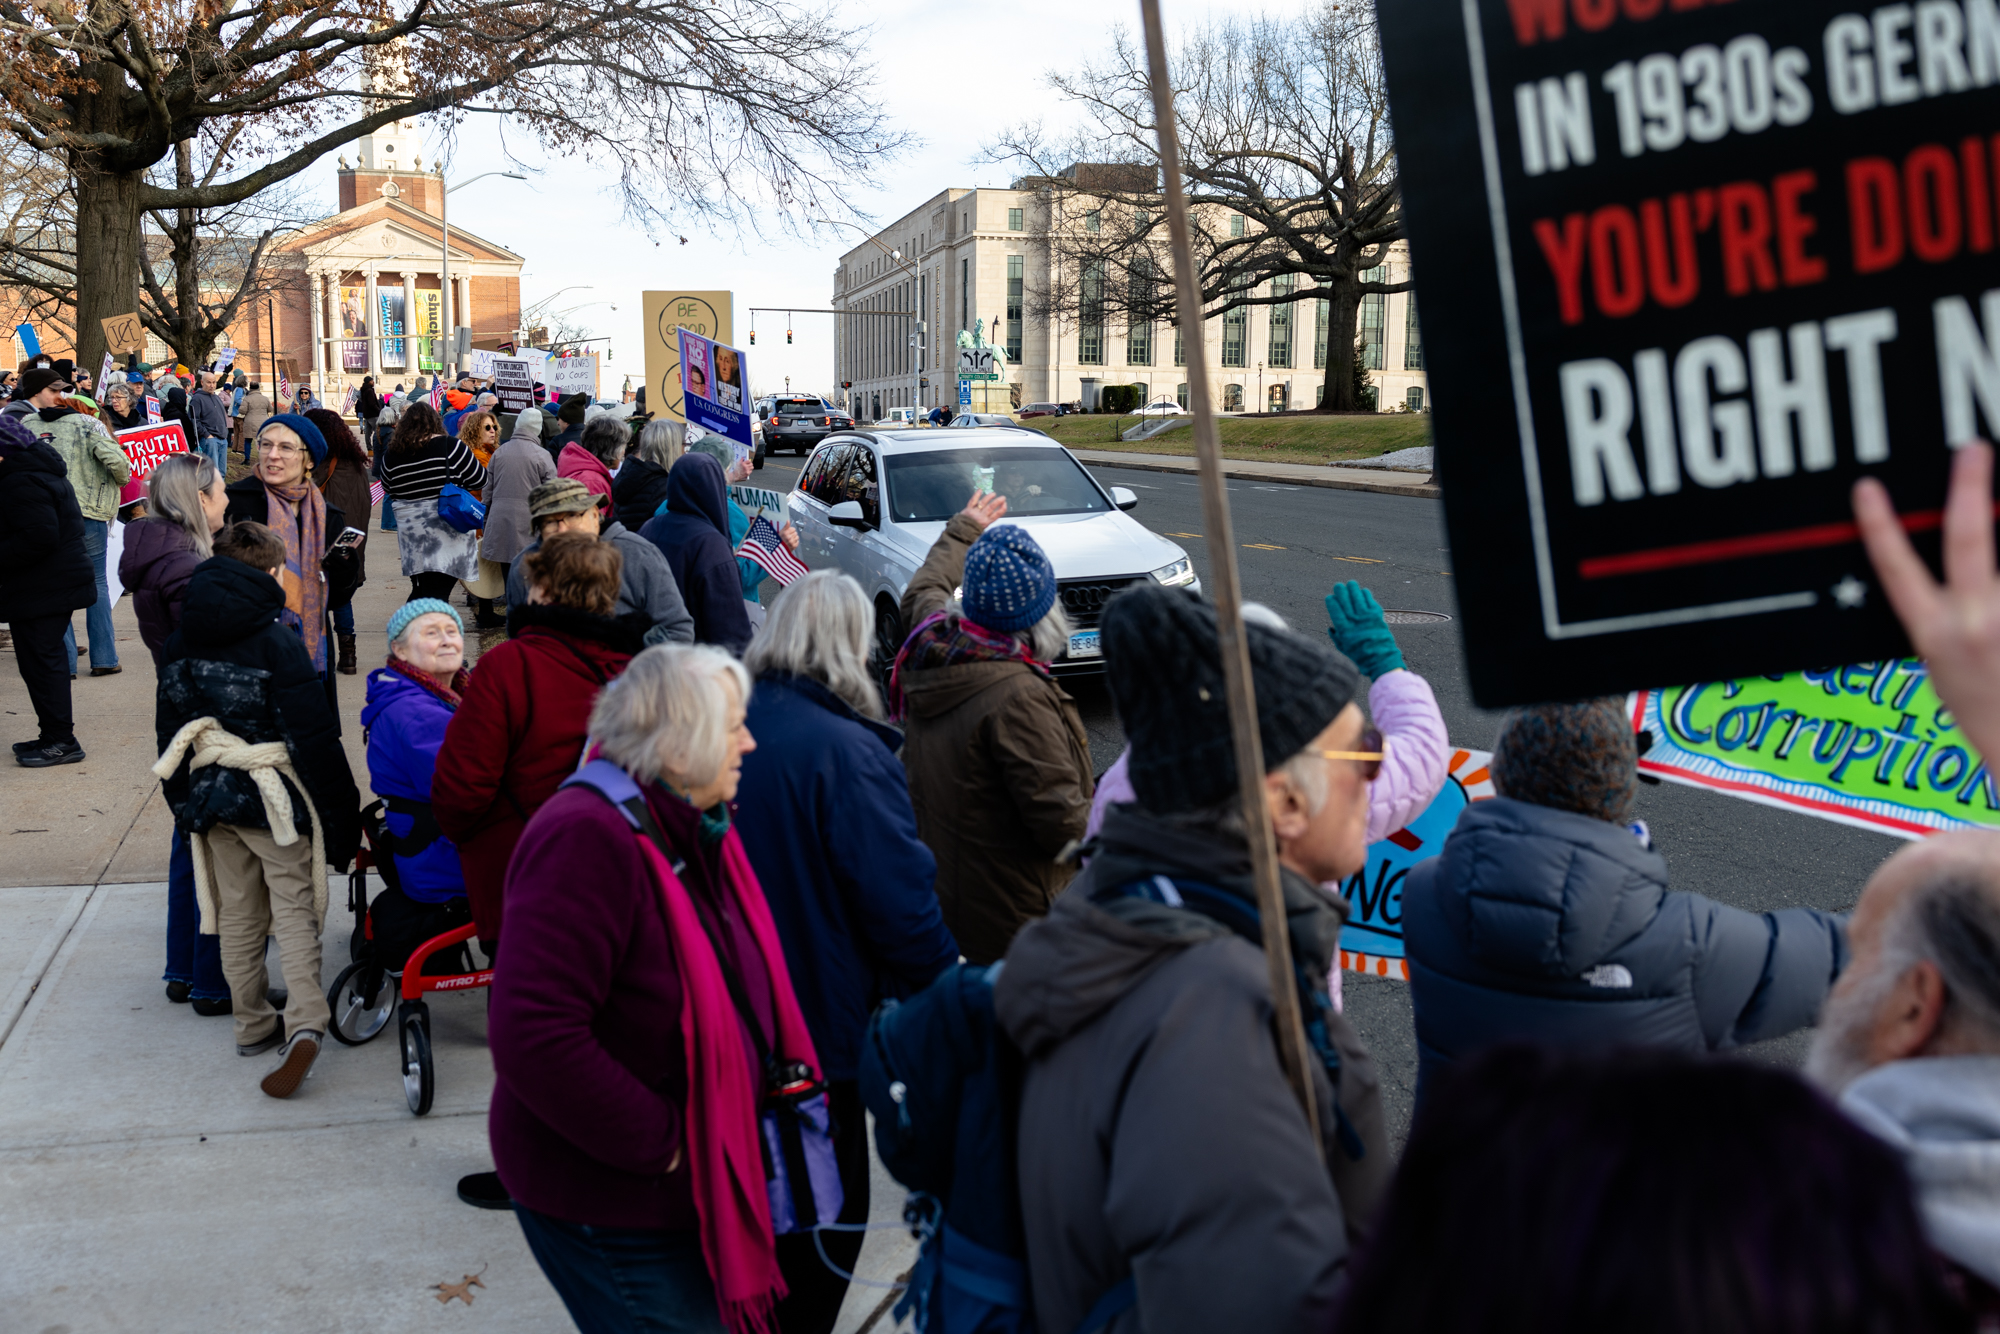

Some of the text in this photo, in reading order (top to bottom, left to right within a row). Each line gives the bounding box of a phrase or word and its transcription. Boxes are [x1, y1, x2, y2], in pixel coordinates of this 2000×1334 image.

[1514, 70, 1597, 176] IN
[1602, 33, 1813, 158] 1930s
[1532, 133, 2000, 325] YOU'RE DOI
[678, 302, 698, 317] BE
[343, 341, 367, 350] SUFFS
[689, 345, 704, 360] NO
[477, 352, 497, 364] NO
[527, 355, 543, 366] CE
[557, 358, 589, 370] NO KINGS
[497, 378, 529, 387] POLITICAL OPINION
[555, 371, 589, 381] NO COUPS
[718, 380, 740, 397] HISTORY
[961, 381, 970, 392] H
[508, 390, 531, 401] DIFFERENCE
[508, 400, 527, 409] MORALITY
[1560, 307, 1898, 507] RIGHT
[704, 401, 740, 424] CONGRESS
[123, 433, 180, 458] TRUTH
[129, 454, 171, 477] MATT
[731, 486, 781, 513] HUMAN
[435, 976, 475, 989] NITRO
